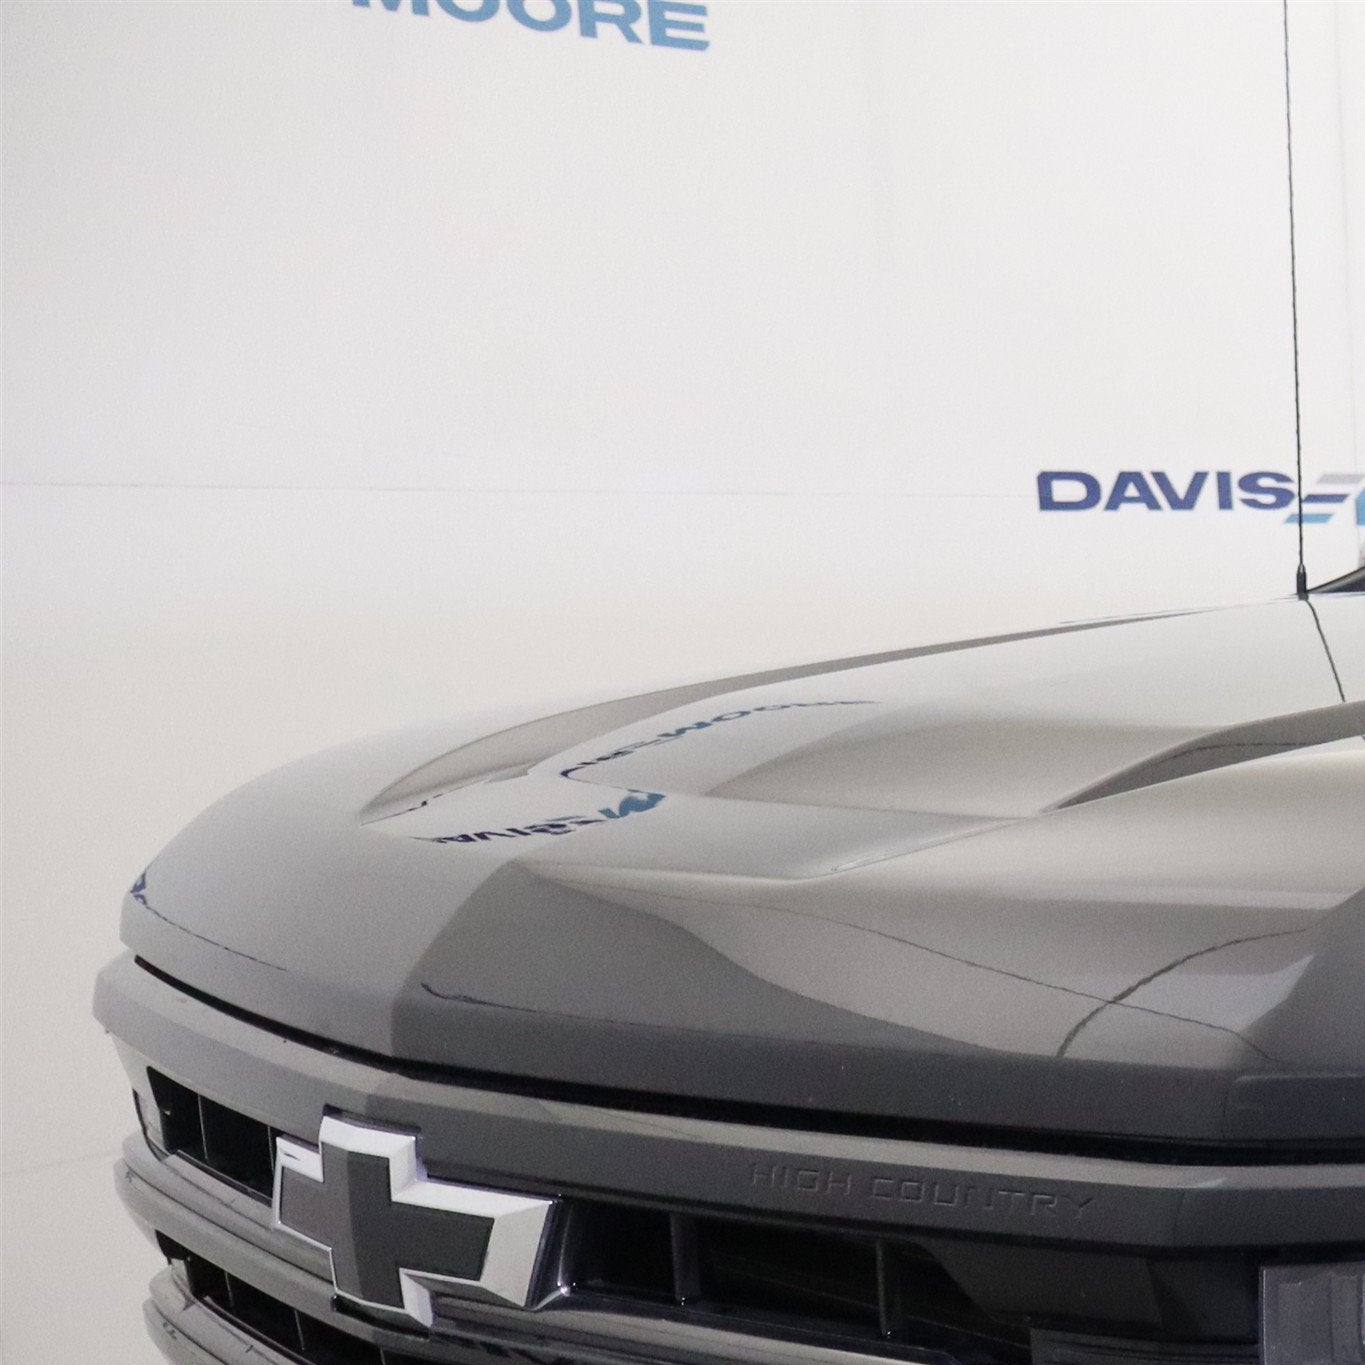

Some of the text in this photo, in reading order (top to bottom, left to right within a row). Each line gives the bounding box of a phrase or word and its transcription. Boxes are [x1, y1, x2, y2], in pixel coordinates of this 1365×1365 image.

[1036, 470, 1297, 512] DAVIS
[750, 1162, 1094, 1219] HIGH COUNTRY
